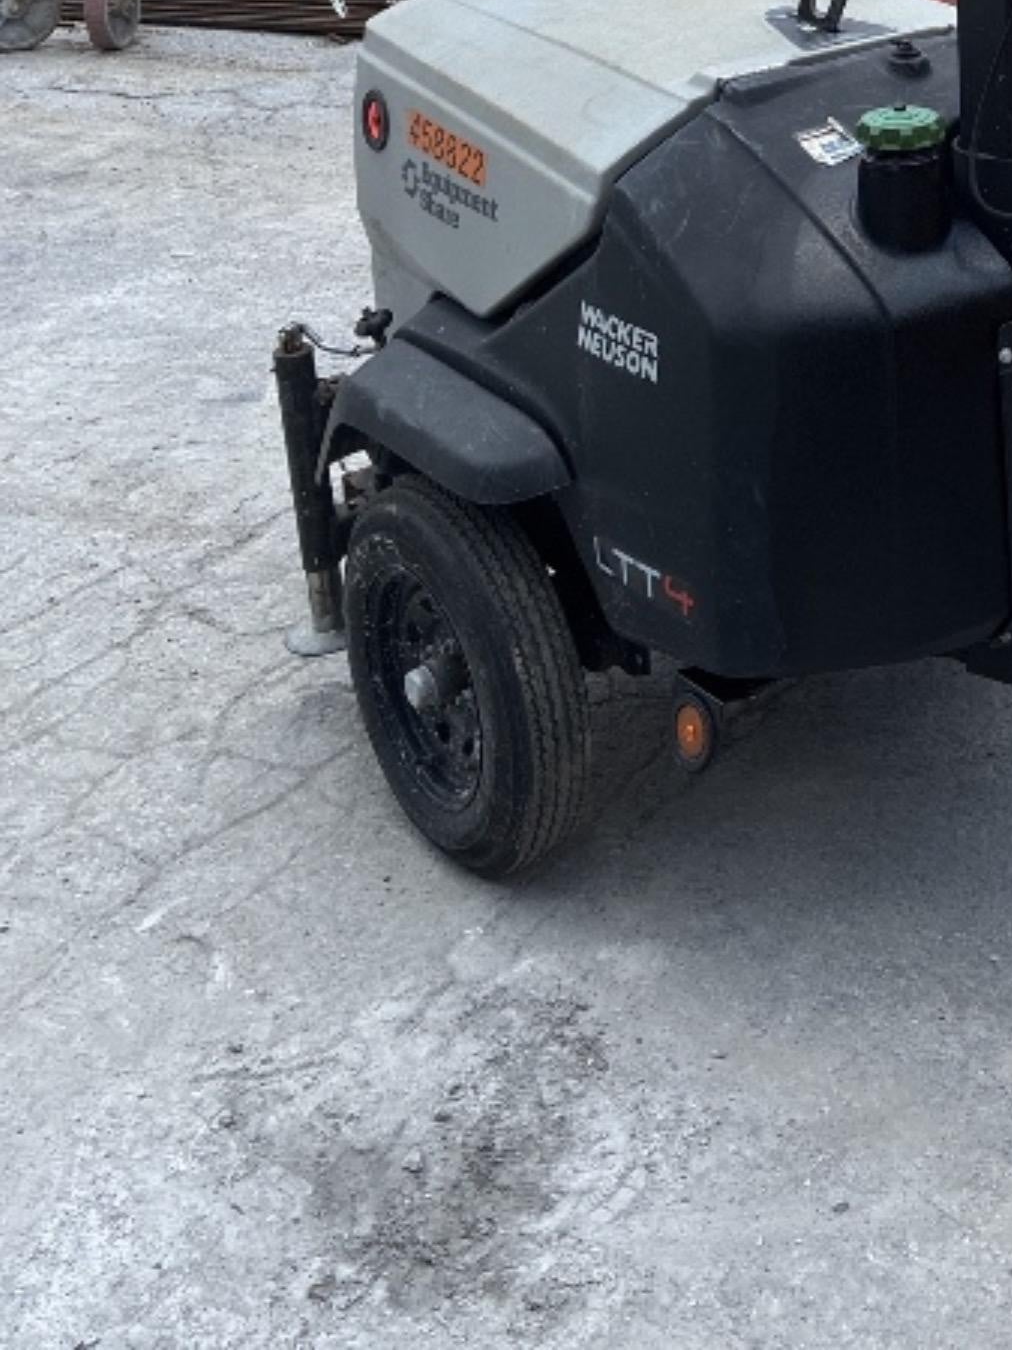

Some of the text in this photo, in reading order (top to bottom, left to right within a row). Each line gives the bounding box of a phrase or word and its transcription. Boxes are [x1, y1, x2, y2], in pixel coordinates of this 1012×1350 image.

[577, 326, 658, 385] NEUSON
[581, 300, 658, 357] WACKER
[592, 535, 694, 617] LTT4
